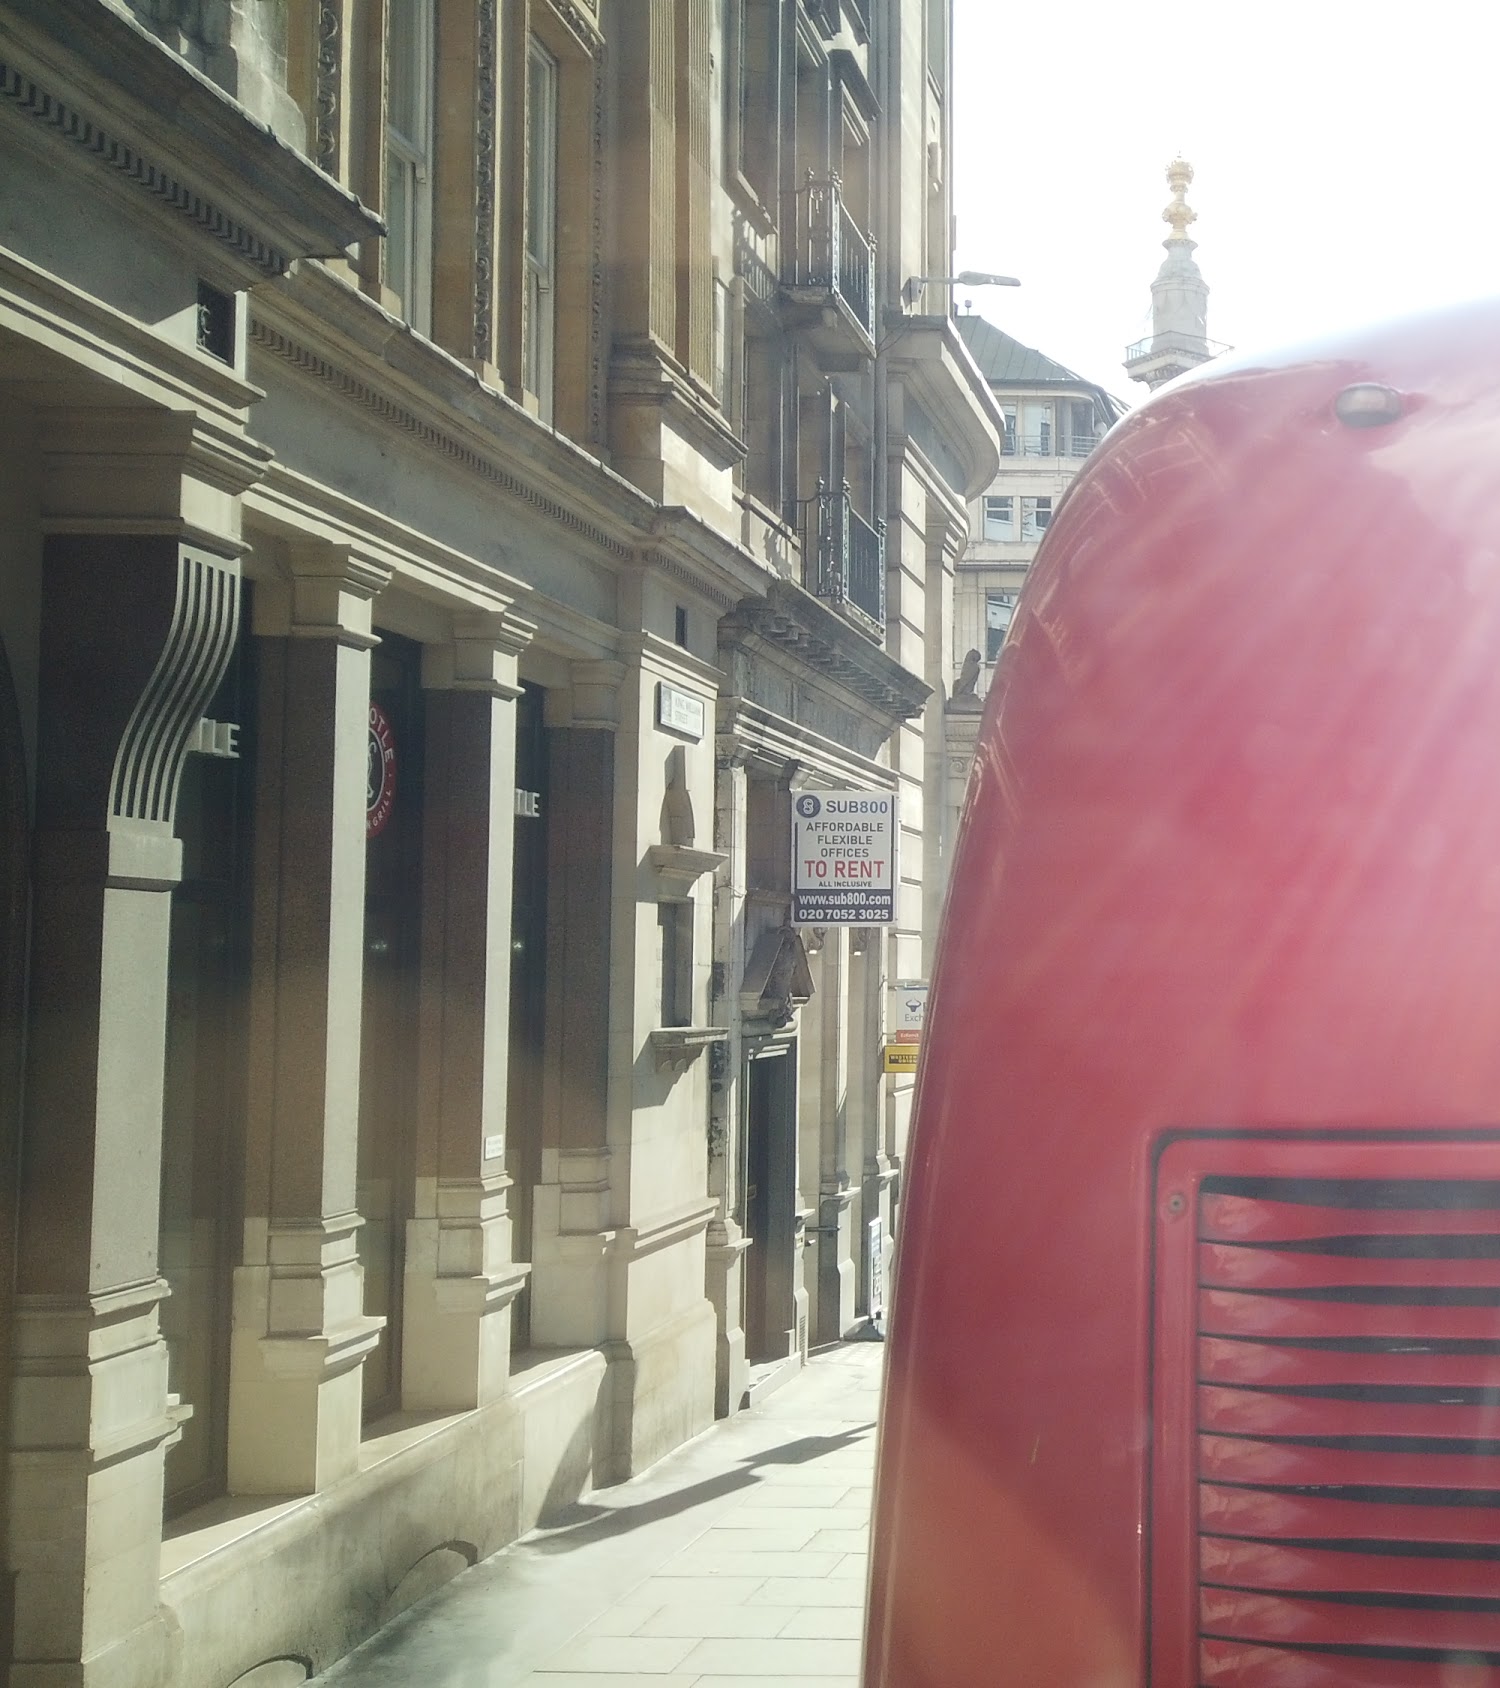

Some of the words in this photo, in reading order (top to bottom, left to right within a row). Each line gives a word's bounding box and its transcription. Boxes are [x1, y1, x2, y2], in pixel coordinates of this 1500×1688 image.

[826, 800, 888, 814] SUB800
[806, 822, 884, 832] AFFORDABLE
[817, 835, 873, 845] FLEXIBLE
[820, 848, 869, 858] OFFICES
[804, 860, 827, 878] TO
[834, 860, 885, 878] RENT
[798, 892, 891, 905] www.sub800.com
[798, 909, 824, 920] 020
[825, 909, 856, 920] 7052
[858, 909, 889, 920] 3025
